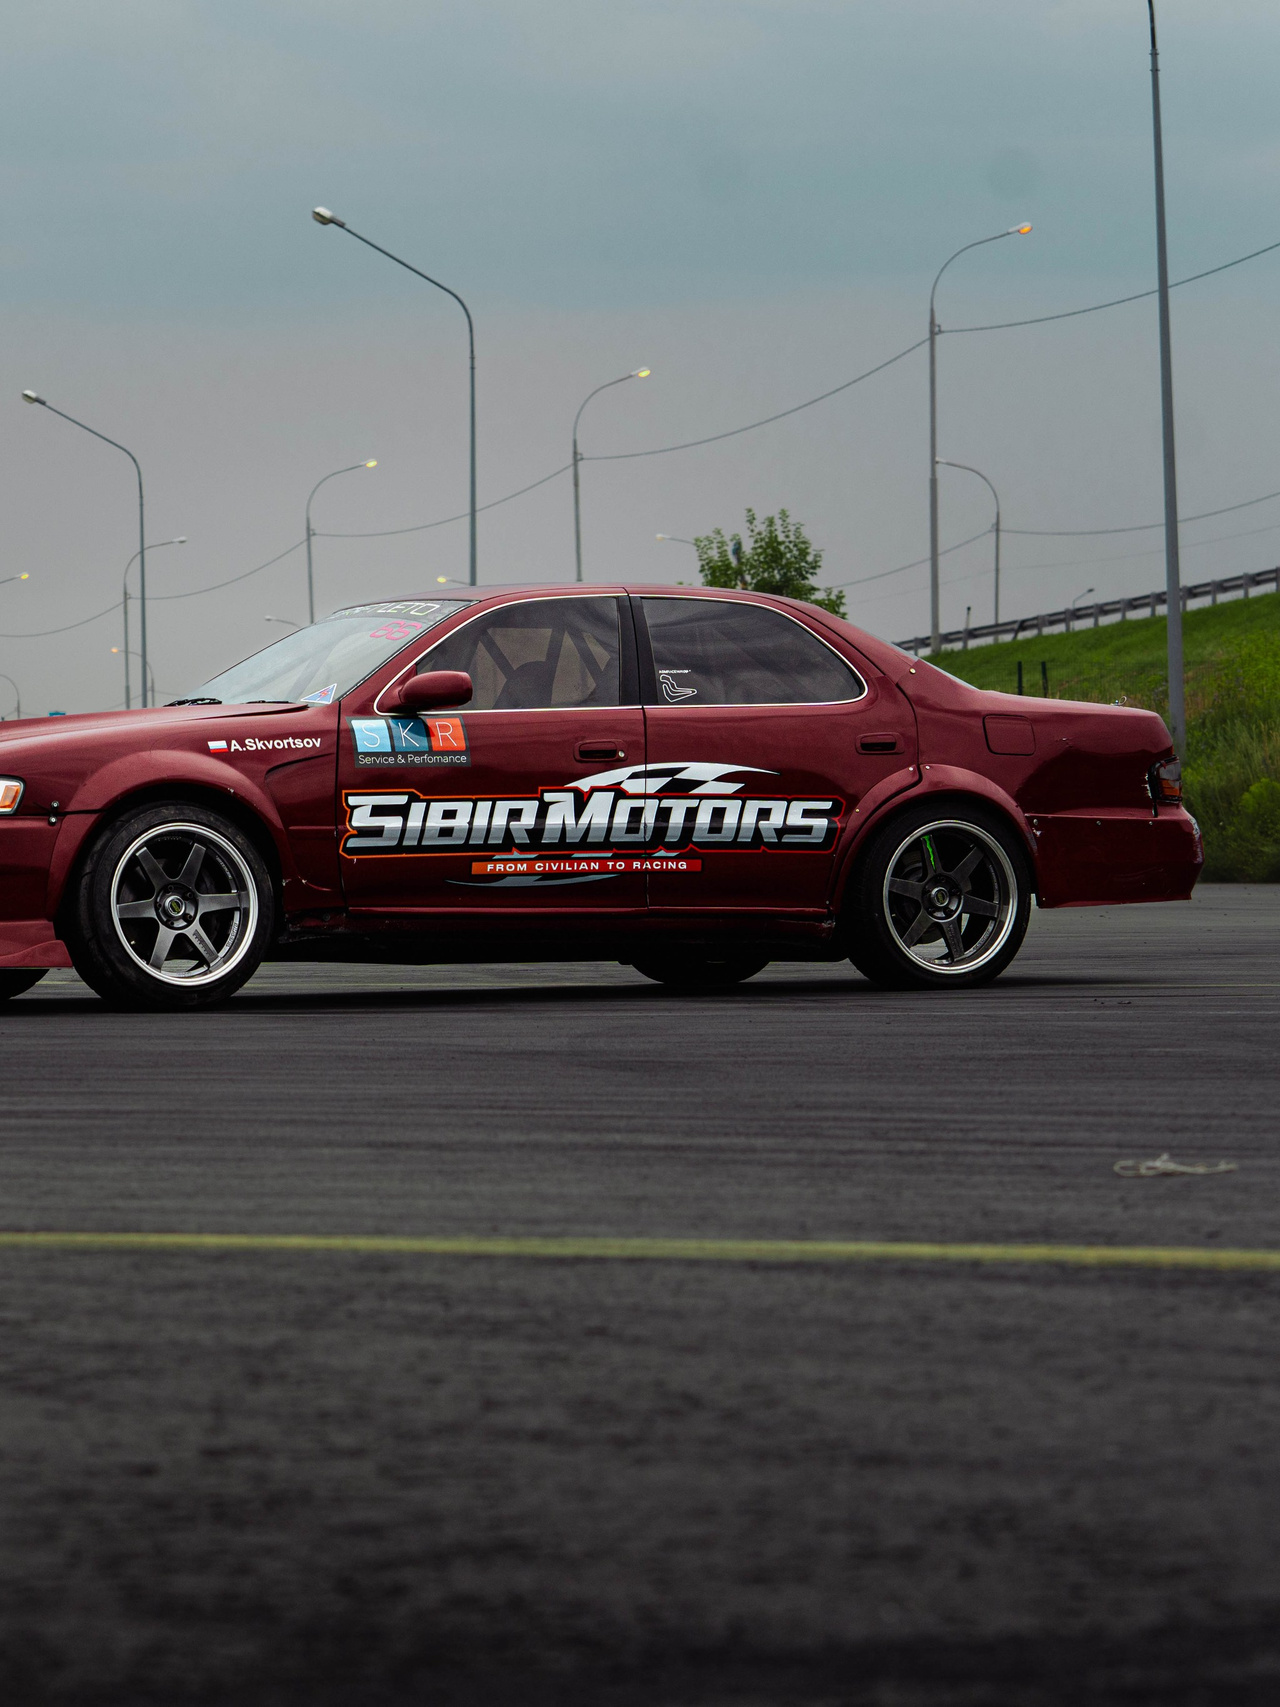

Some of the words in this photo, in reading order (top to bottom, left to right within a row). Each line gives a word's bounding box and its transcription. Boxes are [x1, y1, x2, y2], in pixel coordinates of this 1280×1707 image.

[369, 620, 423, 641] 66
[230, 737, 321, 752] A.Skvortsov
[358, 755, 395, 765] Service
[396, 754, 406, 764] &
[407, 753, 467, 764] Perfomance
[487, 863, 528, 872] FROM
[534, 862, 600, 871] CIVILIAN
[606, 861, 625, 870] TO
[632, 861, 688, 870] RACING
